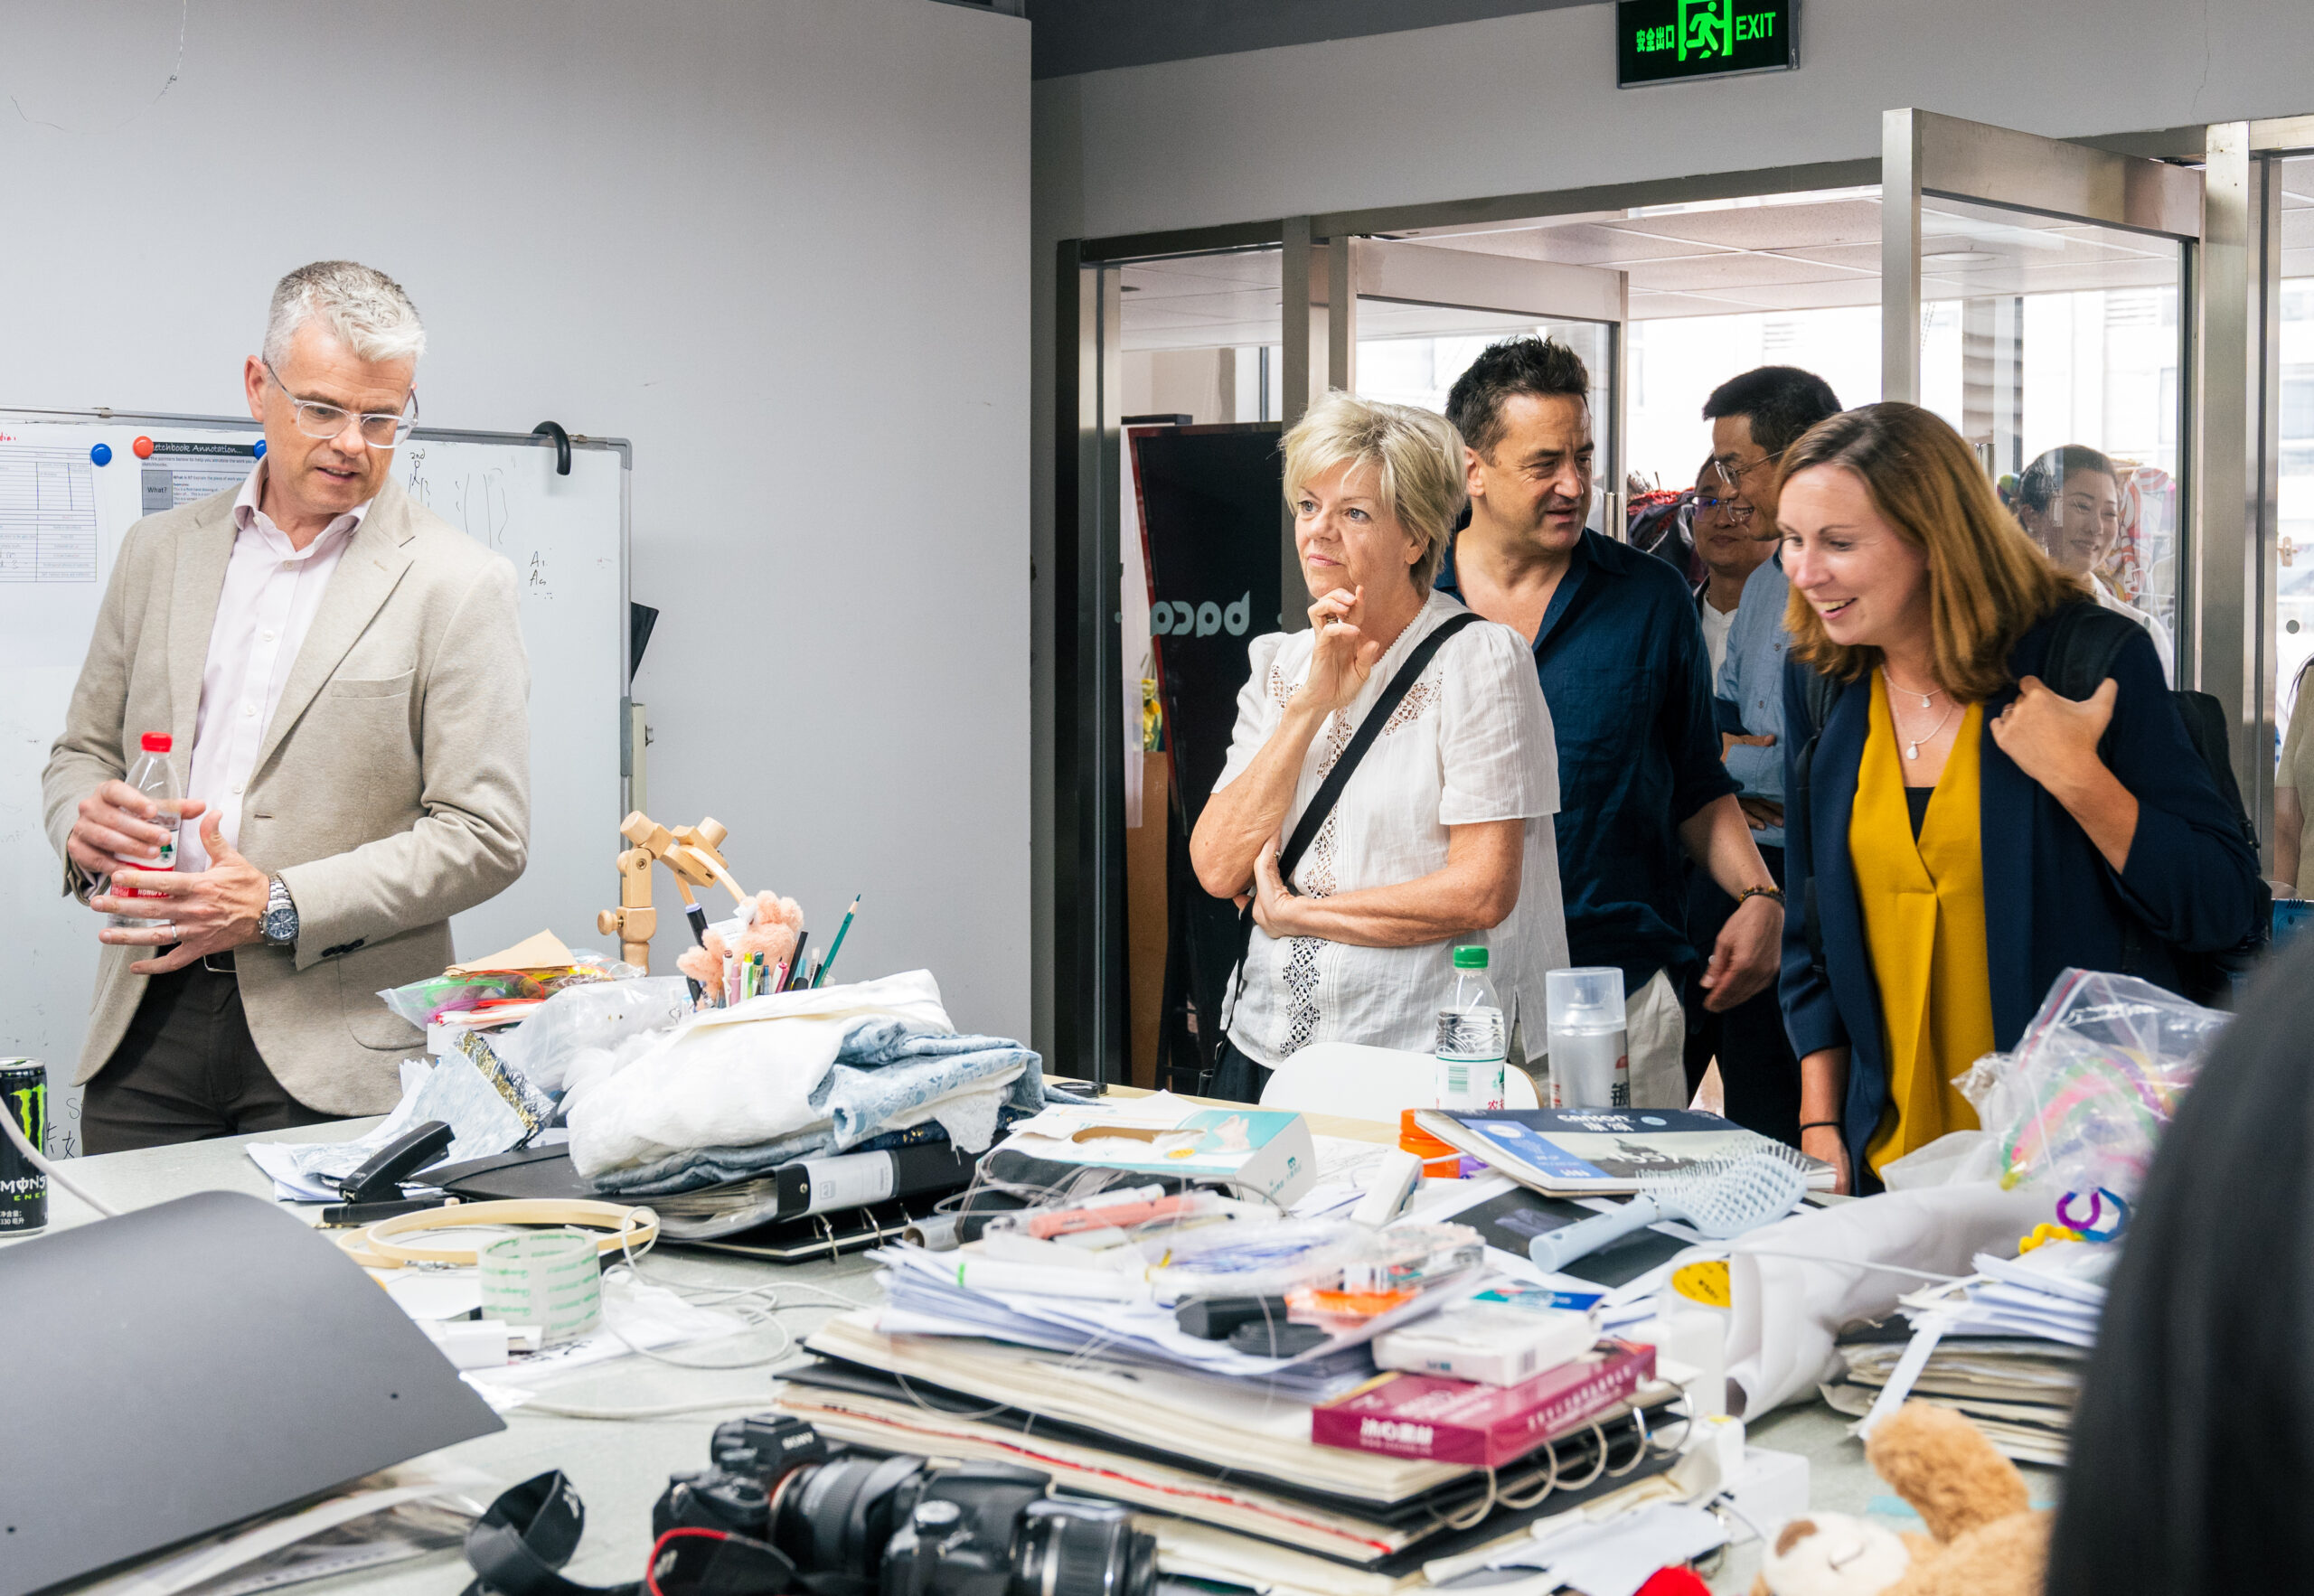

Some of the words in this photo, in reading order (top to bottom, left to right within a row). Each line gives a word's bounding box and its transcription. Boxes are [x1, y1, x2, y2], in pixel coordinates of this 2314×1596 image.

[1636, 24, 1675, 52] 安全出口
[1736, 12, 1776, 41] EXIT
[154, 443, 191, 453] etchbook
[781, 1431, 814, 1450] SONY
